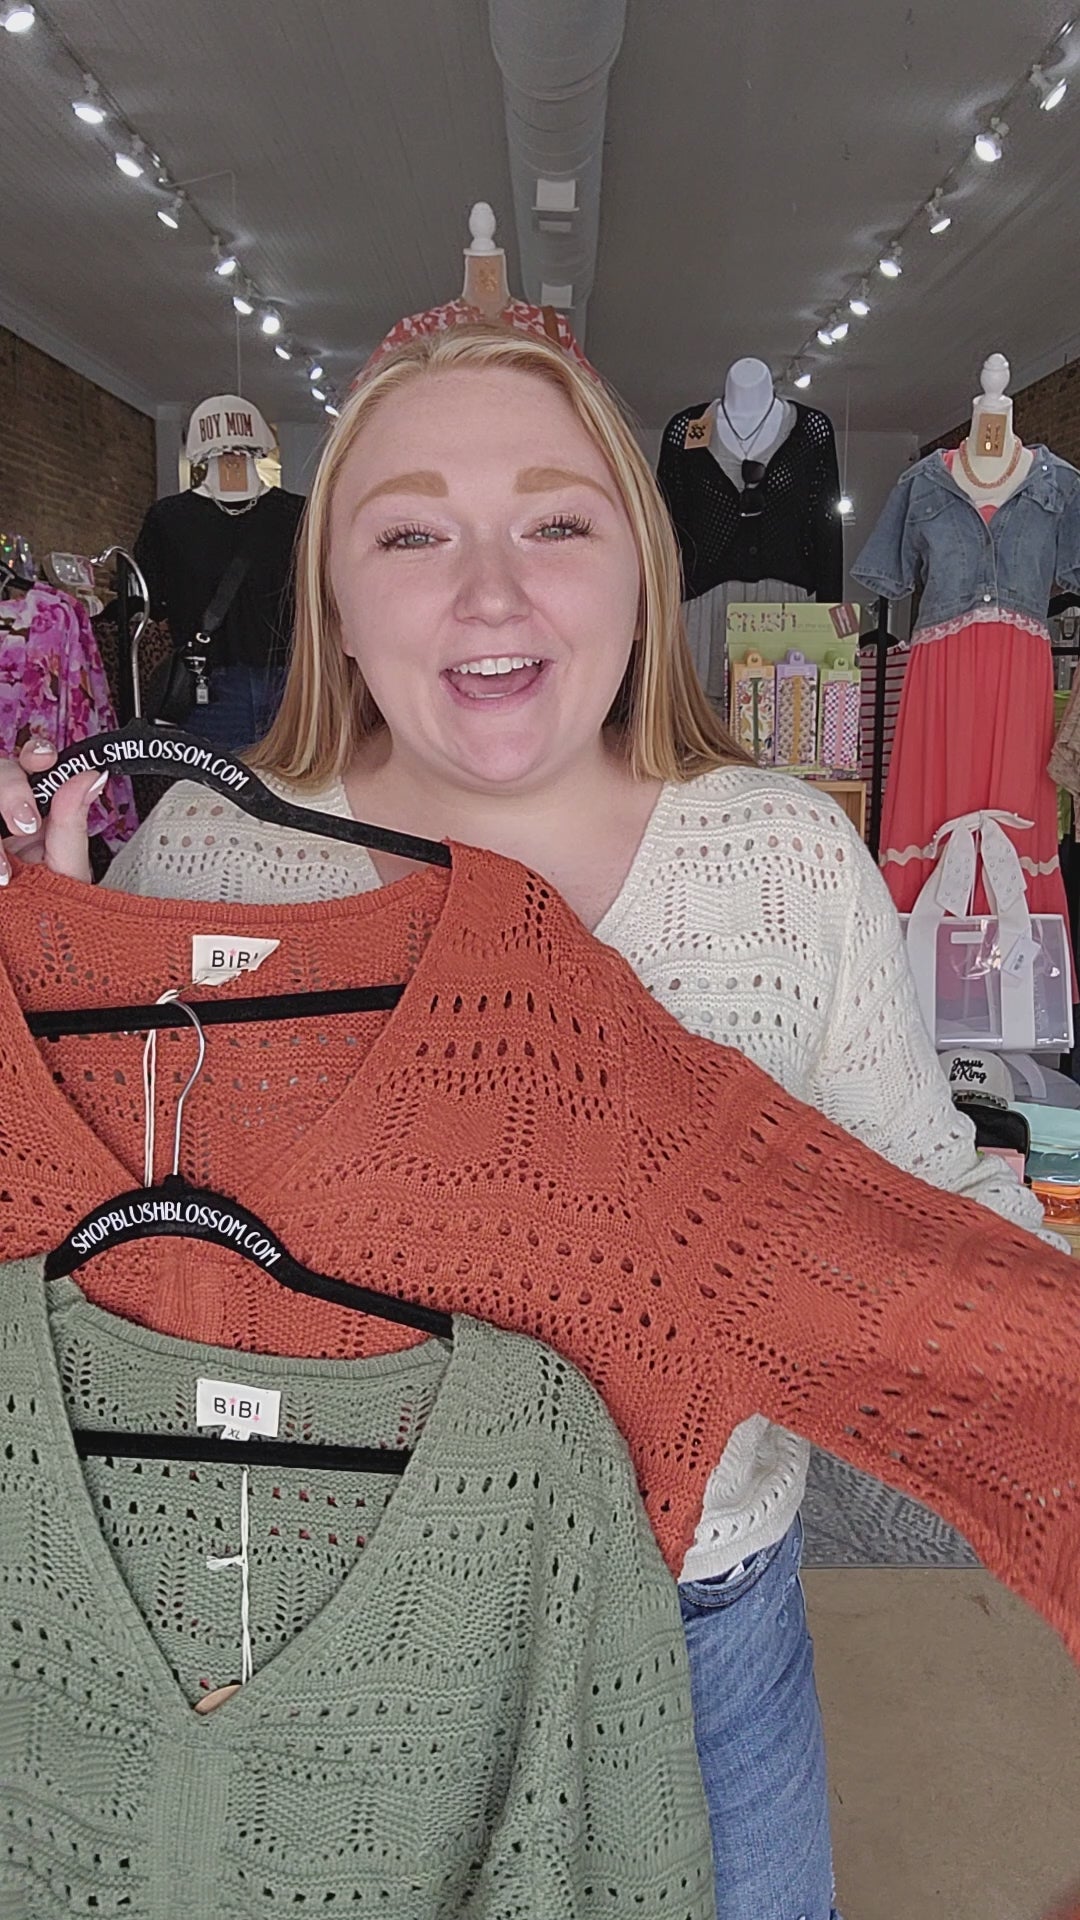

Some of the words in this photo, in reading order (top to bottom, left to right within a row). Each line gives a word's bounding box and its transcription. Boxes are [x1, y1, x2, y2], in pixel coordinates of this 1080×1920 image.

[199, 413, 221, 442] BOY
[225, 412, 253, 437] MOM
[71, 1201, 281, 1267] SHOPBLUSHBLOSSOM.COM
